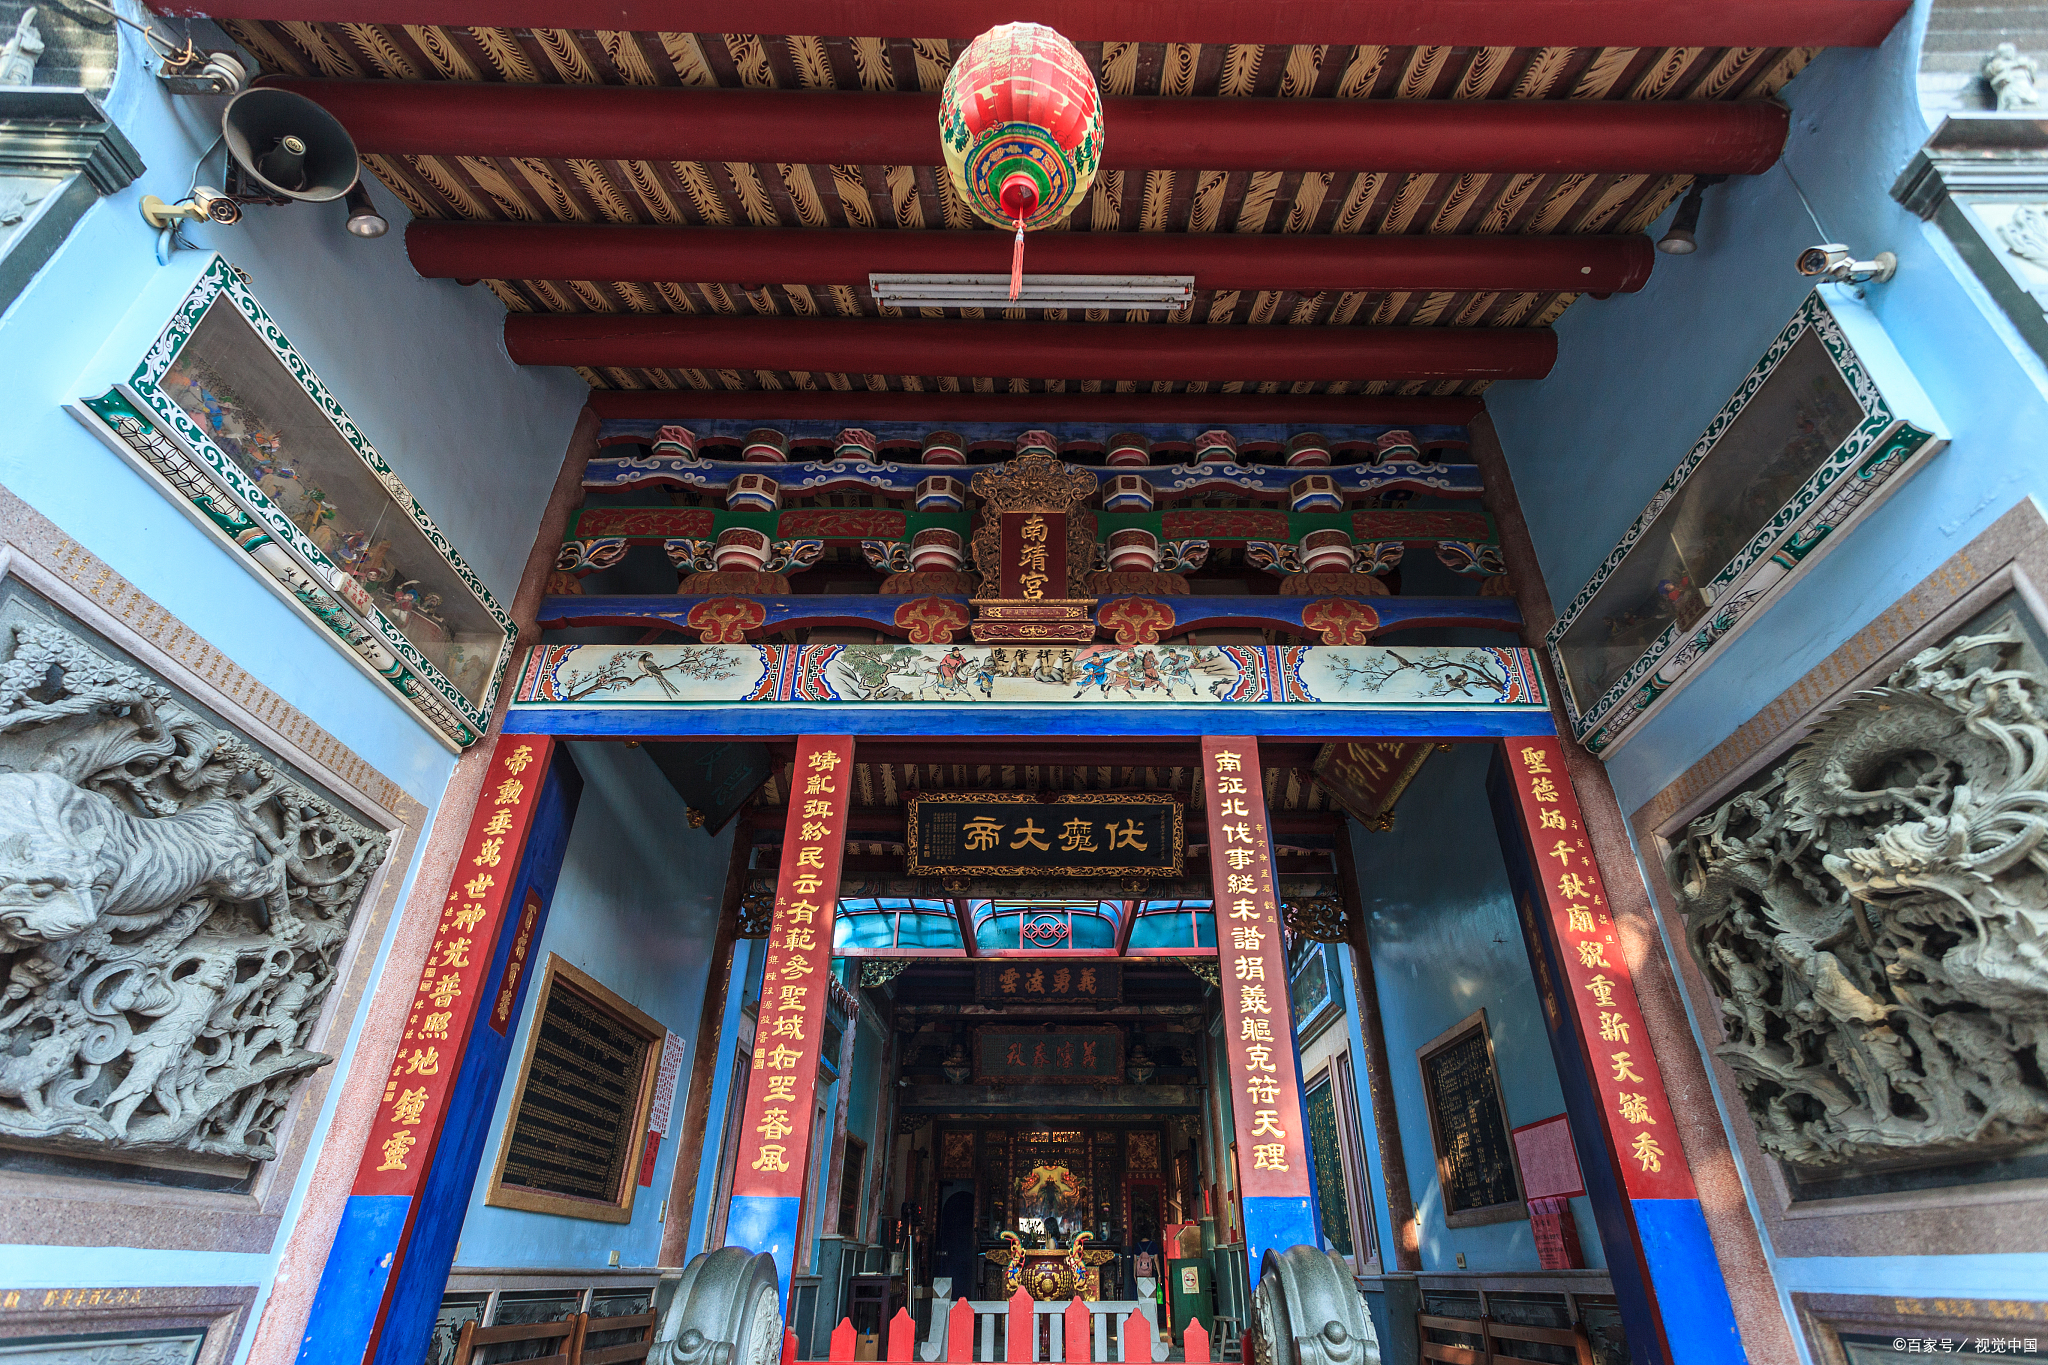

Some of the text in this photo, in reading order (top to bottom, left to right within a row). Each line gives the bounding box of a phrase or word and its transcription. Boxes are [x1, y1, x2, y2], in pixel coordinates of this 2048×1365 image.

[1018, 513, 1050, 600] 南靖宮
[962, 815, 1149, 853] 伏魔大帝
[998, 966, 1098, 995] 義勇凌雲
